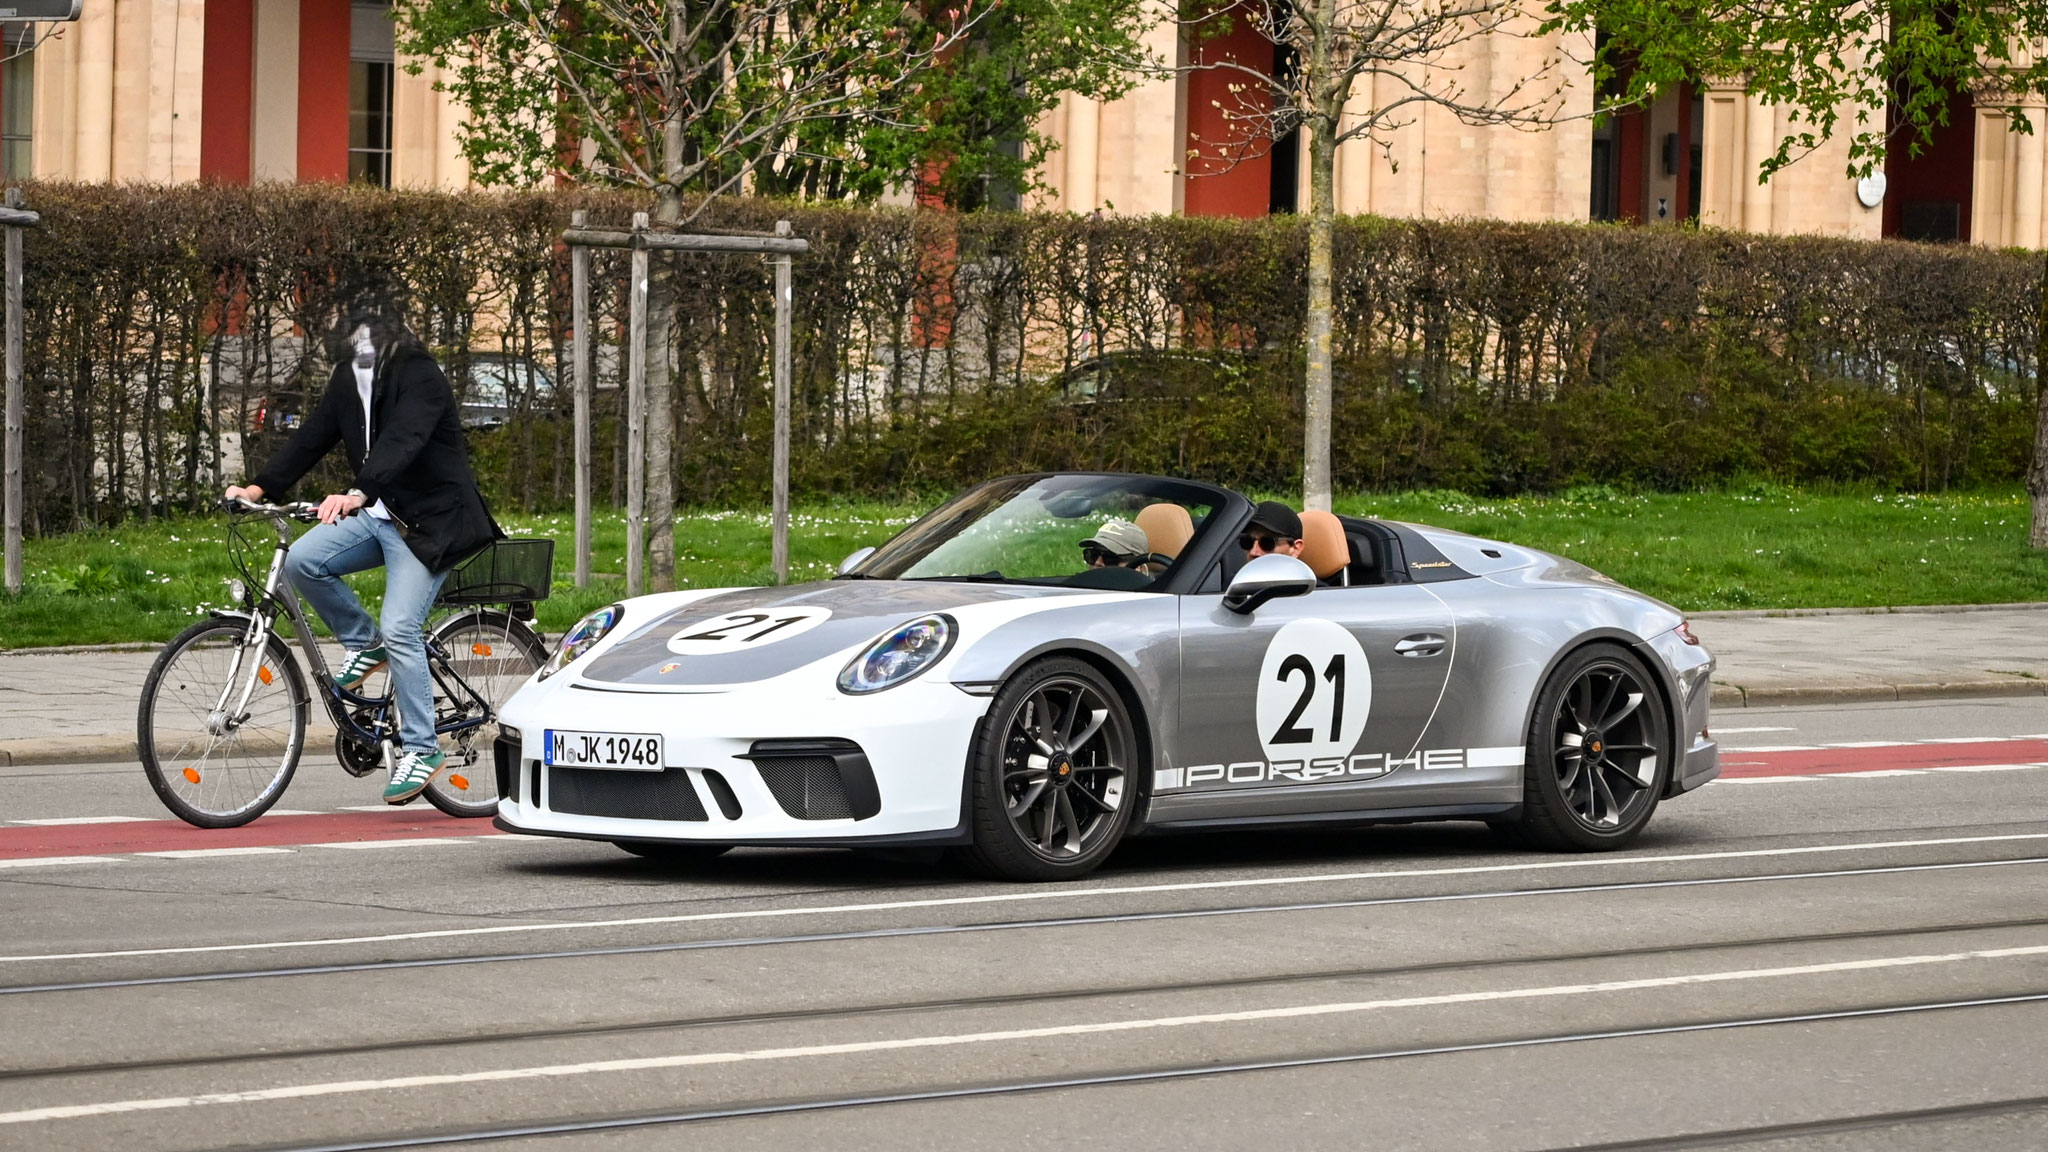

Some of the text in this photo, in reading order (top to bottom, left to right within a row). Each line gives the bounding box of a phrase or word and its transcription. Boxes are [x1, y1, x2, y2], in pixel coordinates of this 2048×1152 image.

[676, 614, 812, 643] 21
[1268, 653, 1346, 745] 21
[554, 734, 565, 761] M
[606, 737, 659, 766] 1948
[1186, 748, 1464, 787] PORSCHE
